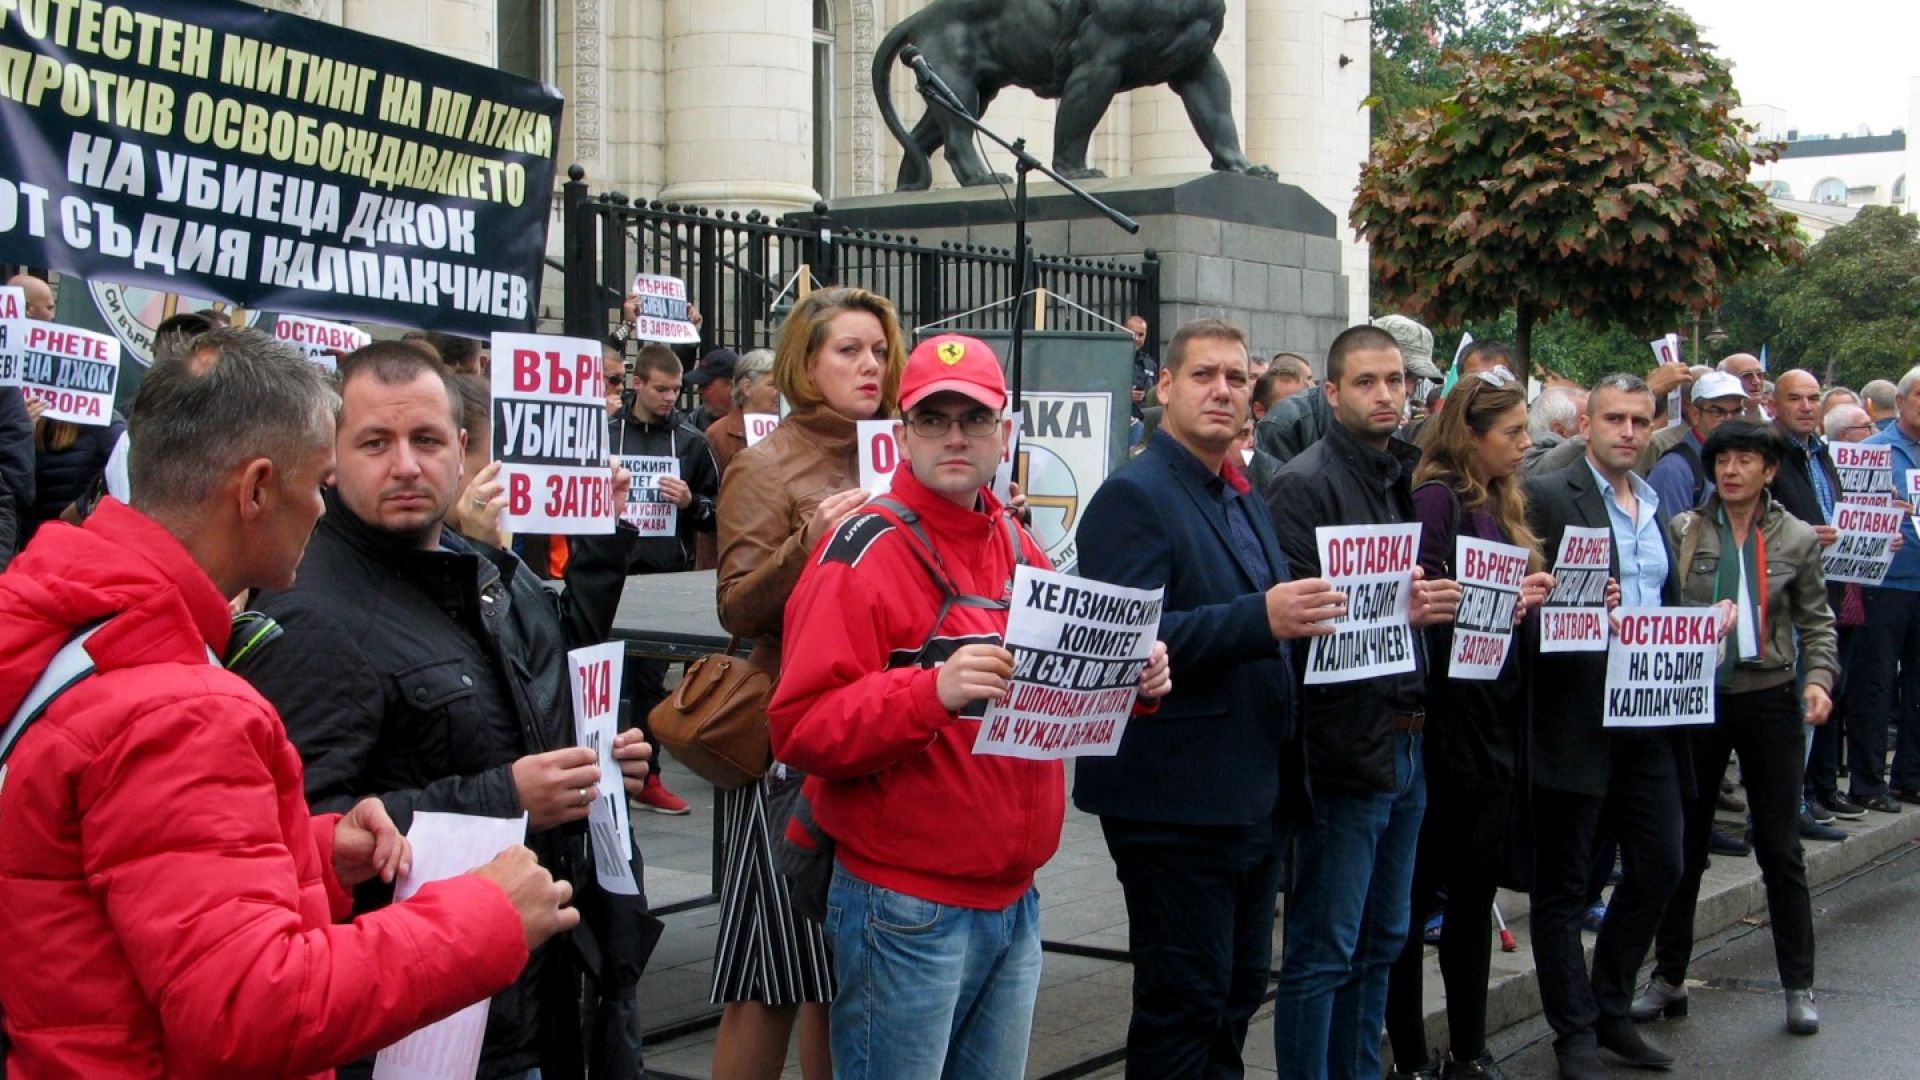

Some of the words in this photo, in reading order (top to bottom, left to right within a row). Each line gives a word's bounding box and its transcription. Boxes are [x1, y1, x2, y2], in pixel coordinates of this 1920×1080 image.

[220, 32, 377, 116] МИТИНГ
[379, 73, 423, 129] НА
[426, 86, 473, 141] ПП
[467, 99, 553, 158] АТАКА
[0, 44, 175, 136] ПРОТИВ
[184, 91, 526, 208] ОСВОБОЖДАВАНЕТО
[67, 131, 146, 197] НА
[156, 149, 341, 237] УБИЕЦА
[342, 191, 476, 255] ДЖОК
[60, 195, 251, 281] СЪДИЯ
[260, 235, 528, 321] КАЛПАКЧИЕВ
[24, 327, 109, 360] РНЕТЕ
[640, 319, 648, 334] В
[56, 358, 113, 393] ДЖОК
[502, 402, 598, 467] УБИЕЦА
[509, 472, 532, 516] В
[544, 473, 613, 518] ЗАТВО
[1838, 509, 1899, 535] ОСТАВКА
[1328, 534, 1413, 578] ОСТАВКА
[1837, 534, 1855, 555] НА
[1353, 580, 1399, 624] СЪДИЯ
[1057, 622, 1142, 657] КОМИТЕТ
[1544, 612, 1550, 641] В
[1552, 612, 1602, 641] ЗАТВОРА
[1620, 614, 1716, 646] ОСТАВКА
[1312, 623, 1410, 673] КАЛПАКЧИЕВ!
[1458, 633, 1505, 667] ЗАТВОРА
[1013, 648, 1038, 678] НА
[1036, 653, 1080, 689] СЪД
[1077, 660, 1105, 687] ПО
[1628, 651, 1649, 682] НА
[1653, 651, 1704, 685] СЪДИЯ
[1013, 684, 1090, 718] ШПИОНАЖ
[1608, 685, 1709, 718] КАЛПАКЧИЕВ!
[987, 714, 1011, 742] НА
[1012, 718, 1067, 752] ЧУЖДА
